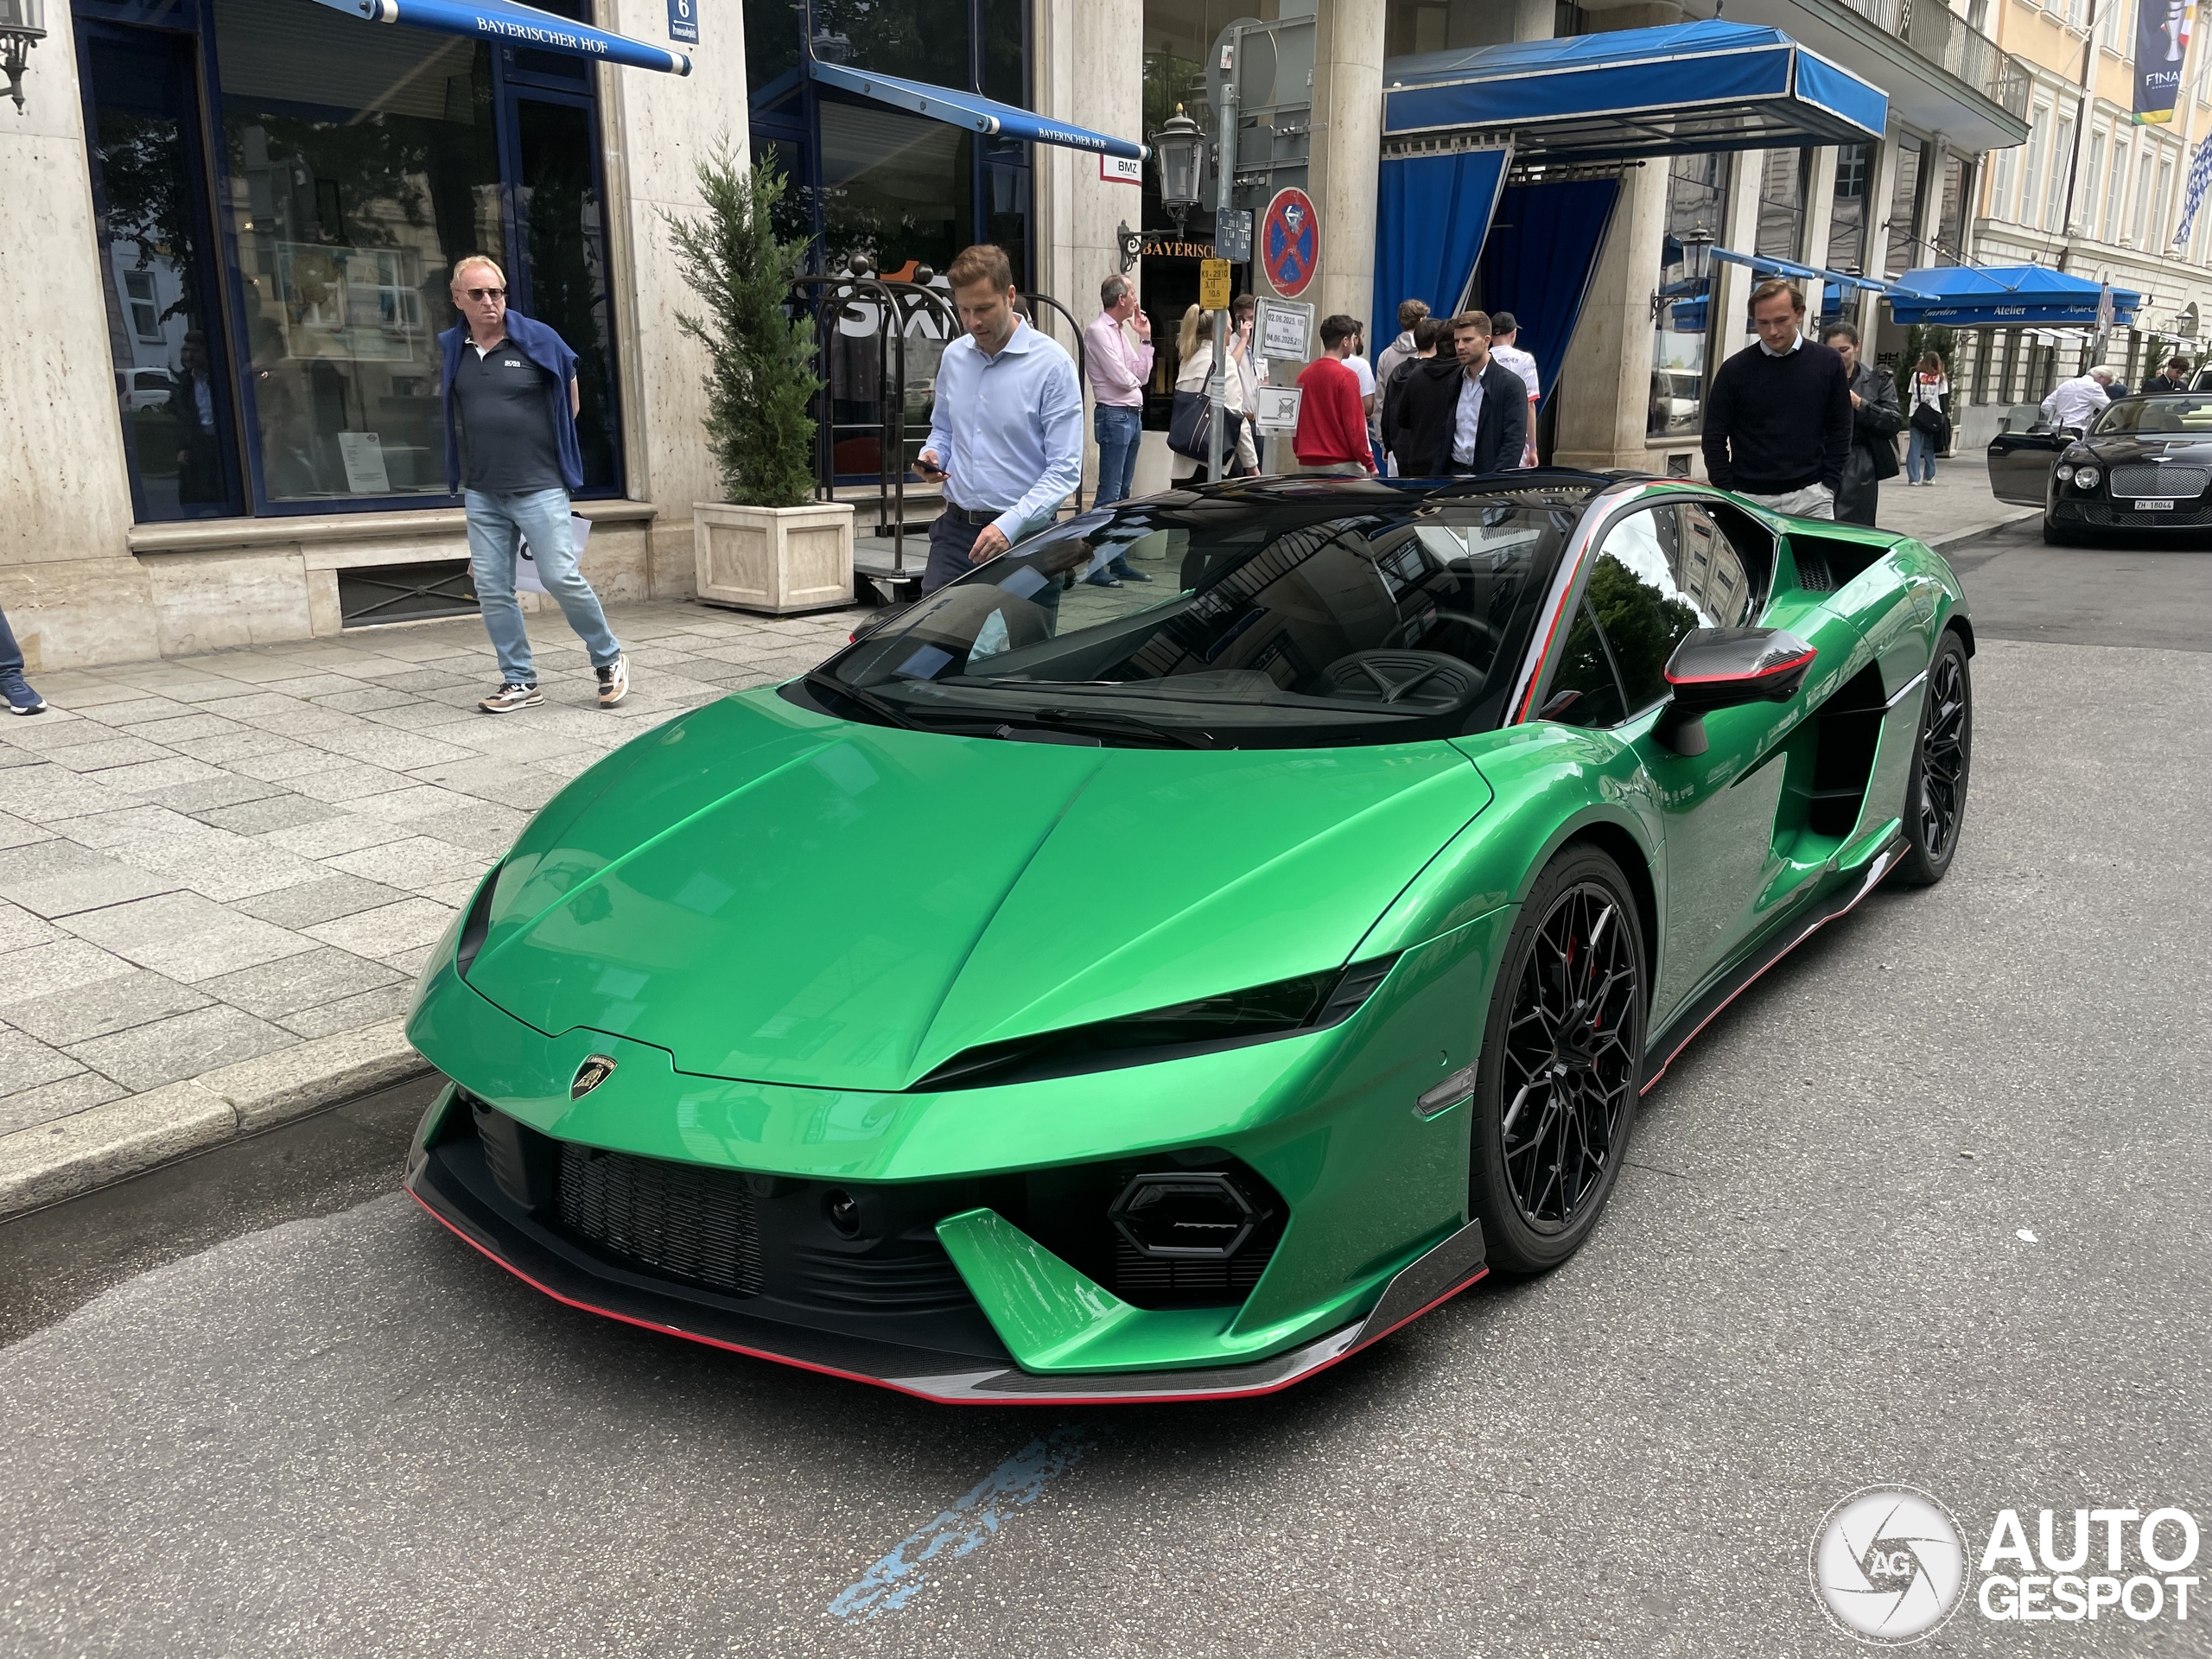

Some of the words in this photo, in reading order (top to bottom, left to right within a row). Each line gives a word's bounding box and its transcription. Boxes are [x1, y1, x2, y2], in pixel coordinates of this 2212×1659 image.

[677, 0, 690, 18] 6
[476, 16, 577, 48] BAYERISCHER
[581, 37, 609, 54] HOF
[1038, 127, 1091, 147] BAYERISCHER
[1092, 138, 1107, 149] HOF
[1118, 161, 1137, 173] BMZ
[1142, 241, 1217, 258] BAYERISCH
[1993, 305, 2026, 315] Atelier
